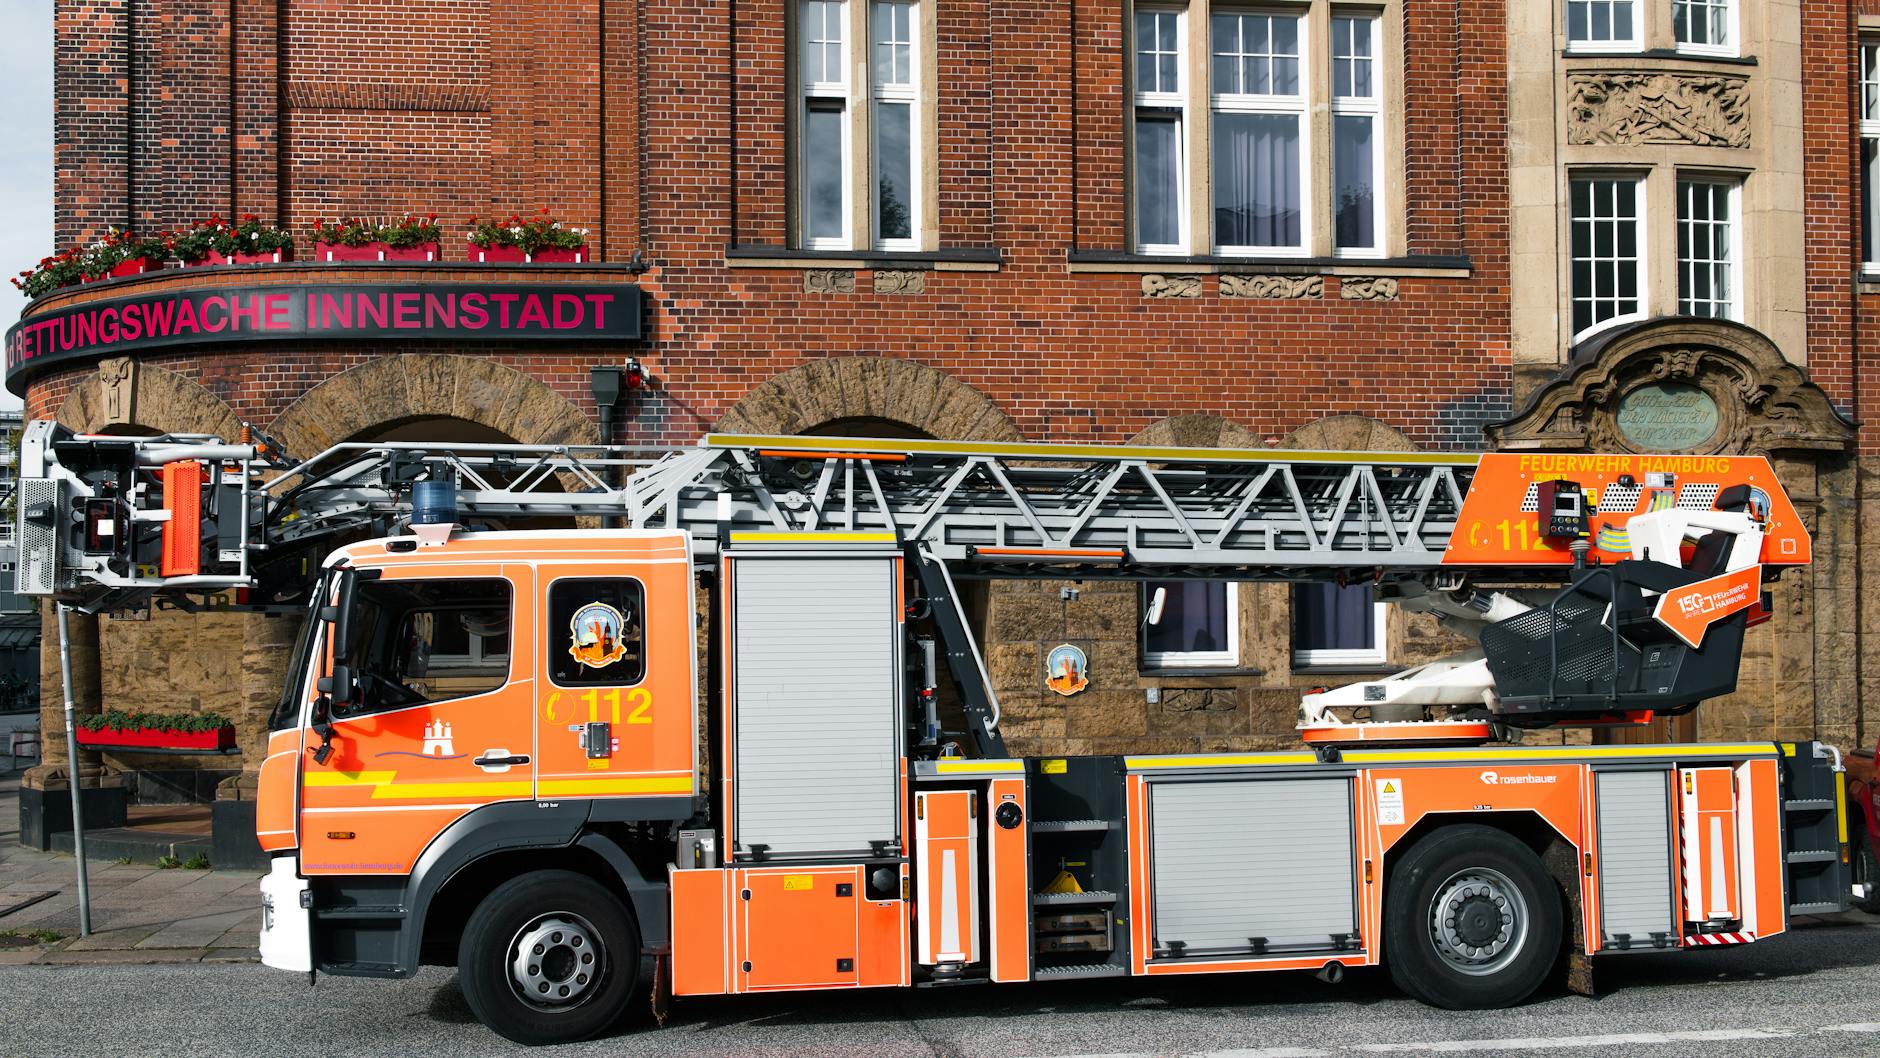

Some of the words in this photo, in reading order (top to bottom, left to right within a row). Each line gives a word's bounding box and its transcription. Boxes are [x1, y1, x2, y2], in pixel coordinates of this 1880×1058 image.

[16, 293, 290, 363] RETTUNGSWACHE
[307, 293, 614, 329] INNENSTADT
[1520, 455, 1630, 472] FEUERWEHR
[1639, 457, 1729, 473] HAMBURG
[1715, 593, 1747, 609] HAMBURG
[581, 688, 652, 724] 112
[1499, 774, 1557, 784] rosenbauer
